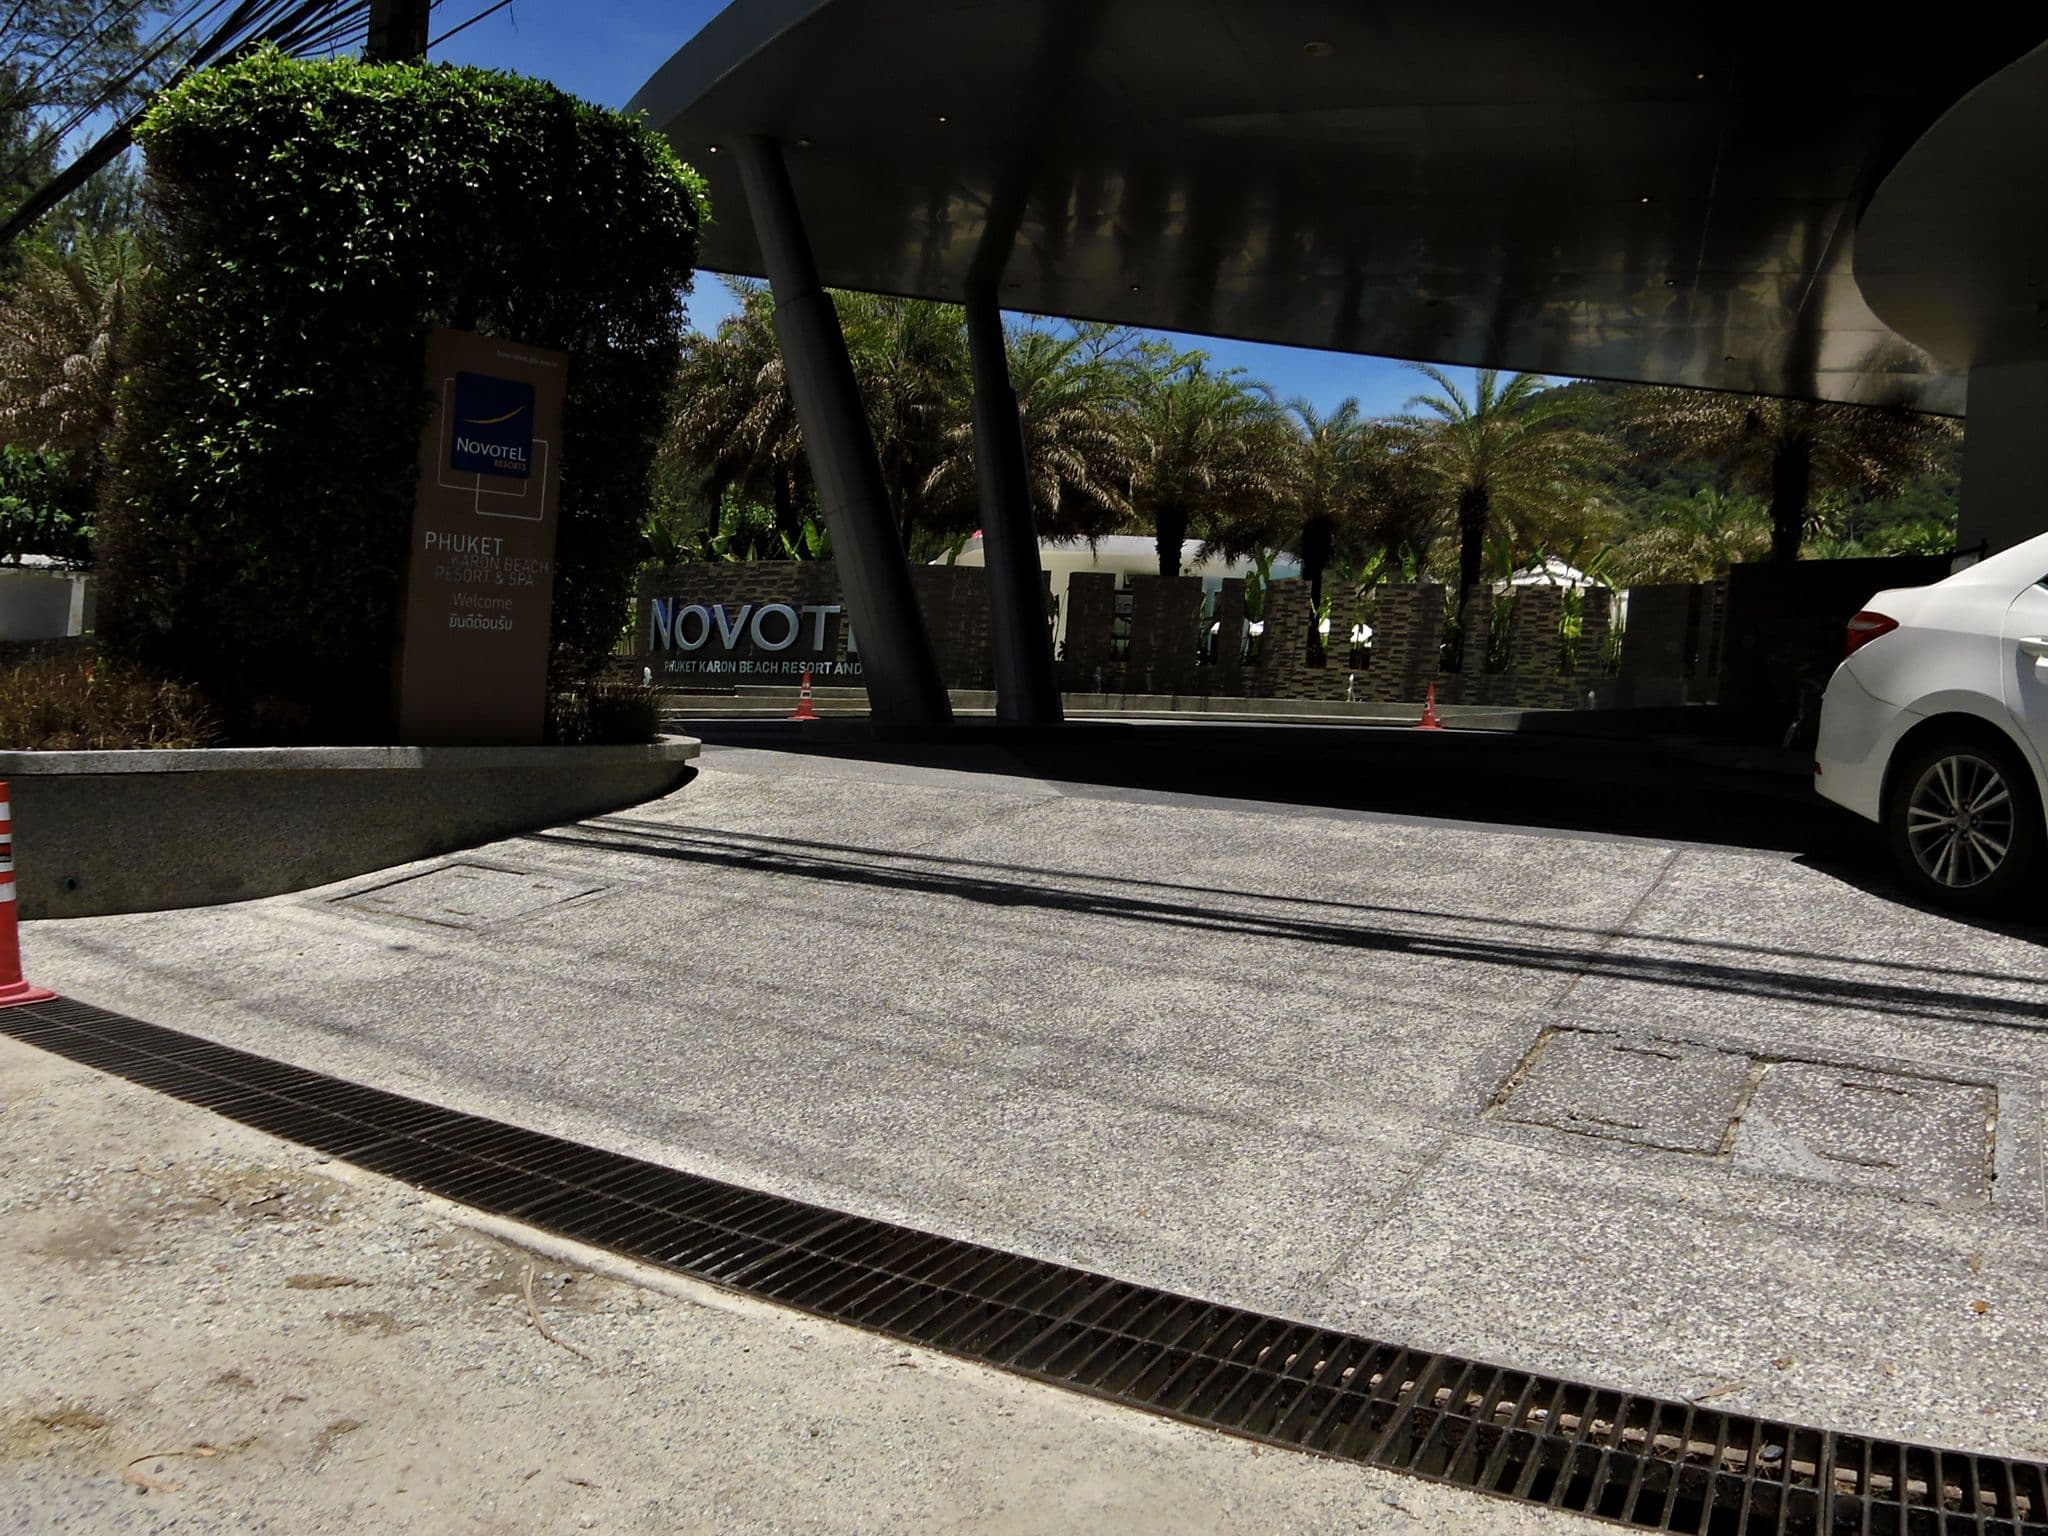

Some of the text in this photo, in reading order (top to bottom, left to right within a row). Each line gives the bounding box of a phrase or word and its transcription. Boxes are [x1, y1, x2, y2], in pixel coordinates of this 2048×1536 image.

[457, 437, 527, 462] NOVOTEL
[425, 531, 504, 556] PHUKET
[451, 554, 549, 576] KARON BEACH
[435, 566, 534, 586] RESORT & SPA
[453, 592, 513, 609] Welcome
[449, 613, 513, 631] ยินดีต้อนรับ
[650, 597, 858, 652] NOVOT
[664, 660, 863, 675] PHUKET KARON BEACH RESORT AND
